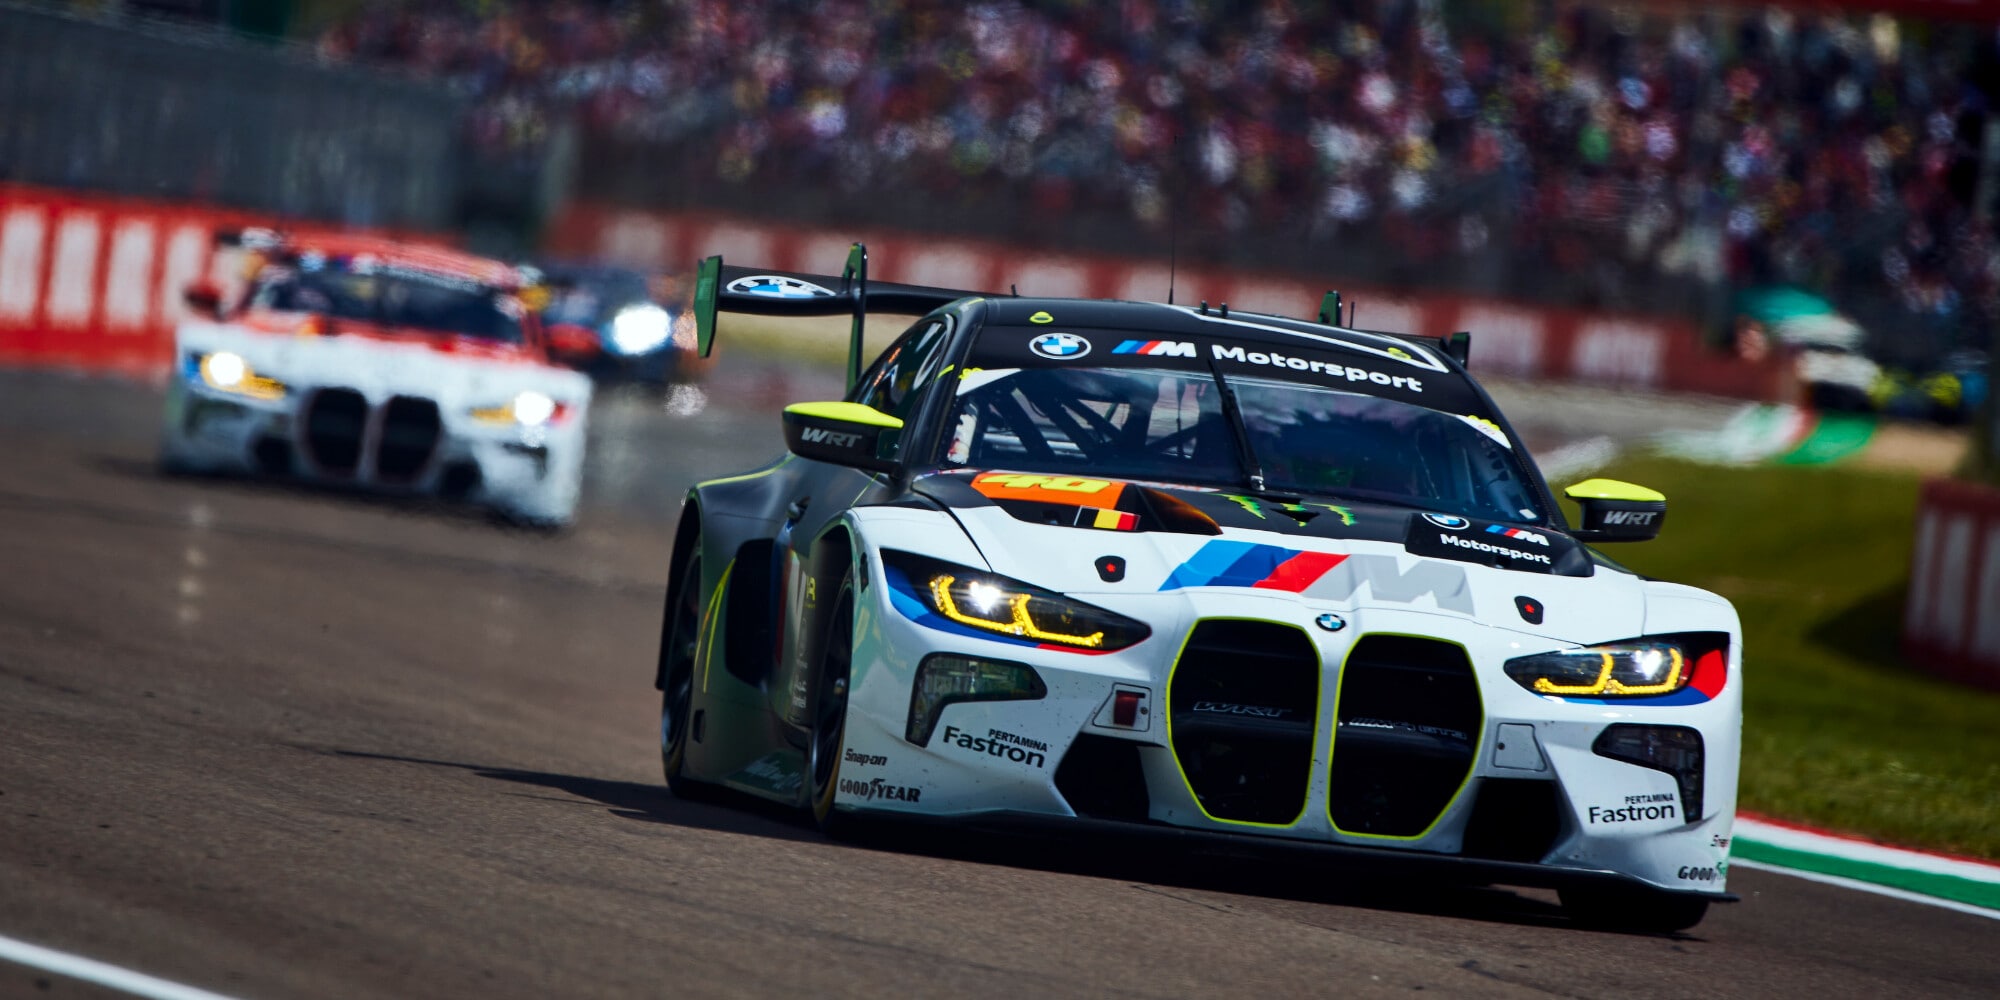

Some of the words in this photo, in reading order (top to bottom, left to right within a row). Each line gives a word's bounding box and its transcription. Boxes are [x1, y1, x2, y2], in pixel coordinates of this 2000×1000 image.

[1211, 344, 1423, 393] Motorsport
[801, 426, 863, 448] WRT
[1603, 510, 1658, 526] WRT
[1440, 533, 1551, 565] Motorsport
[942, 725, 1045, 769] Fastron
[988, 728, 1048, 753] PERTAMINA
[844, 748, 888, 766] Snap-on
[839, 777, 922, 803] GOODYEAR
[1624, 792, 1675, 805] PERTAMINA
[1588, 804, 1676, 824] Fastron
